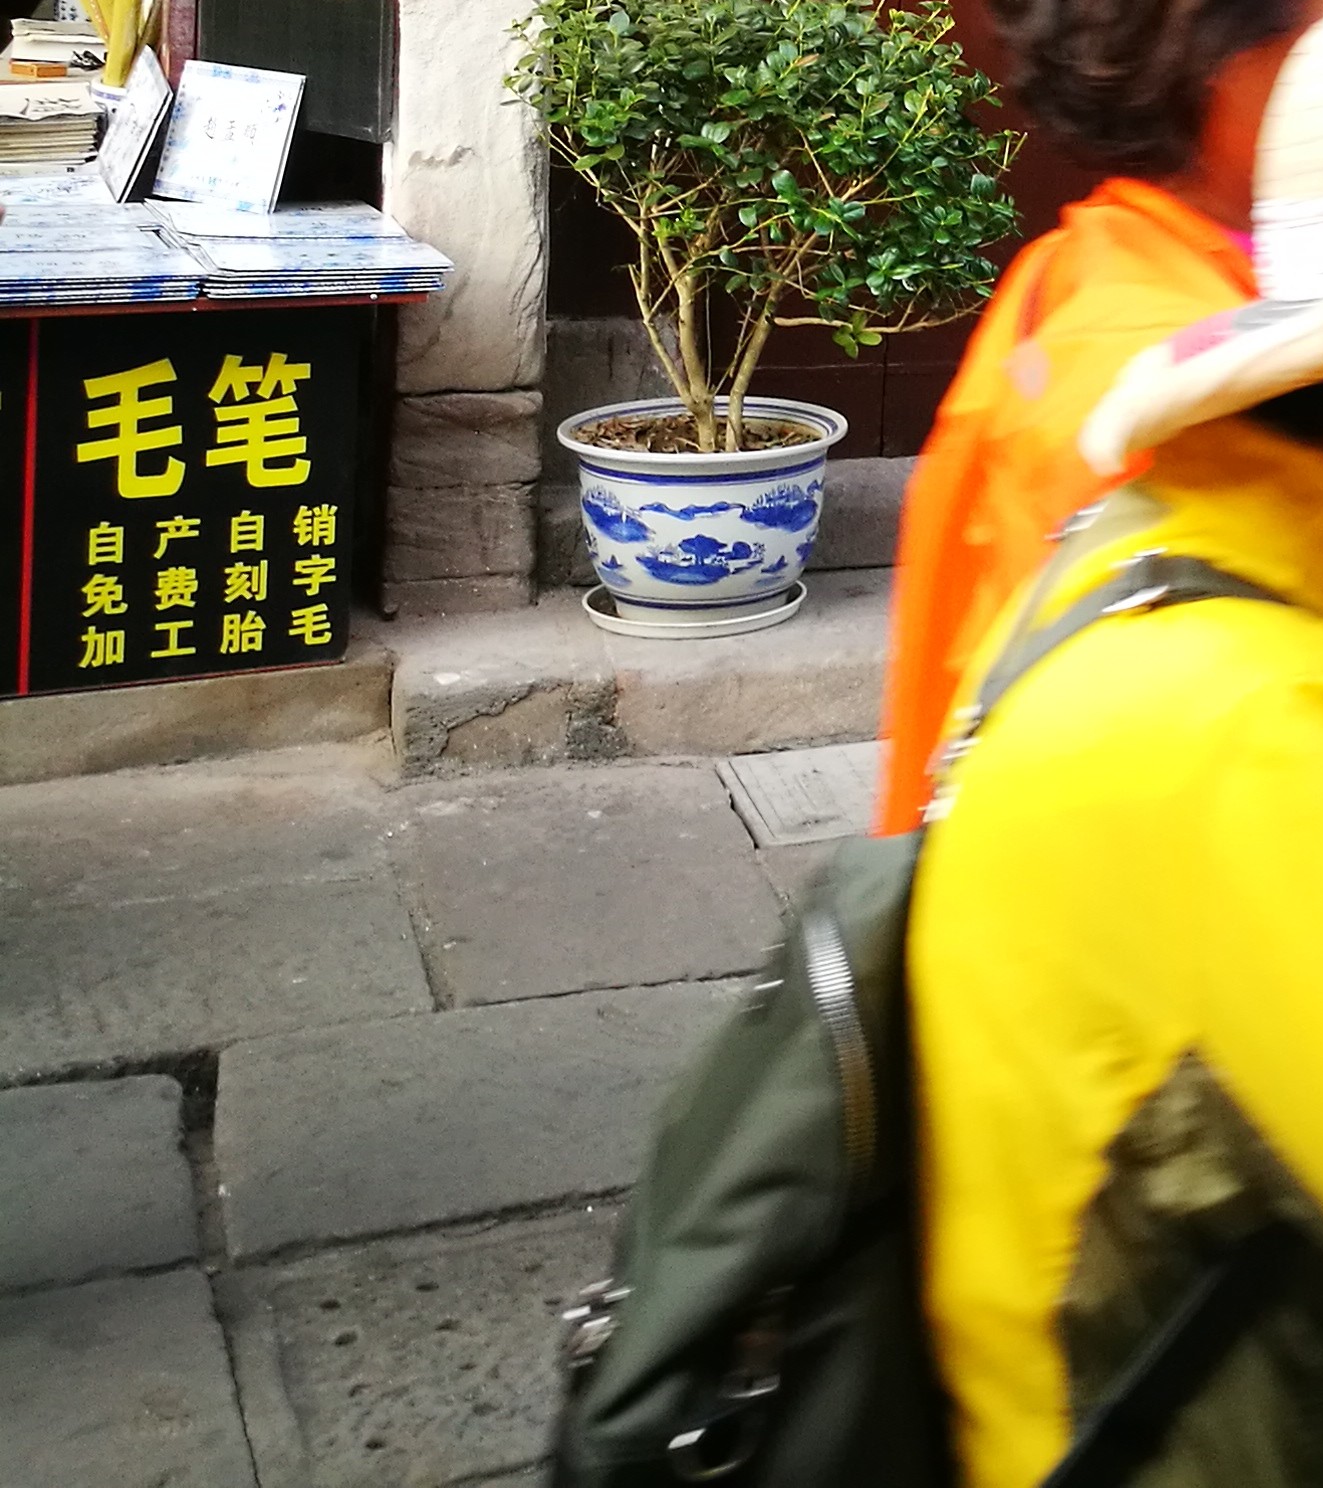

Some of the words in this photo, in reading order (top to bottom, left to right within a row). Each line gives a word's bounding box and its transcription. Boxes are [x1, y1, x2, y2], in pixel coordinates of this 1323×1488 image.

[76, 352, 312, 500] 毛笔
[87, 503, 339, 566] 自产自销
[80, 553, 337, 618] 免费刻字
[78, 603, 332, 669] 加工胎毛
